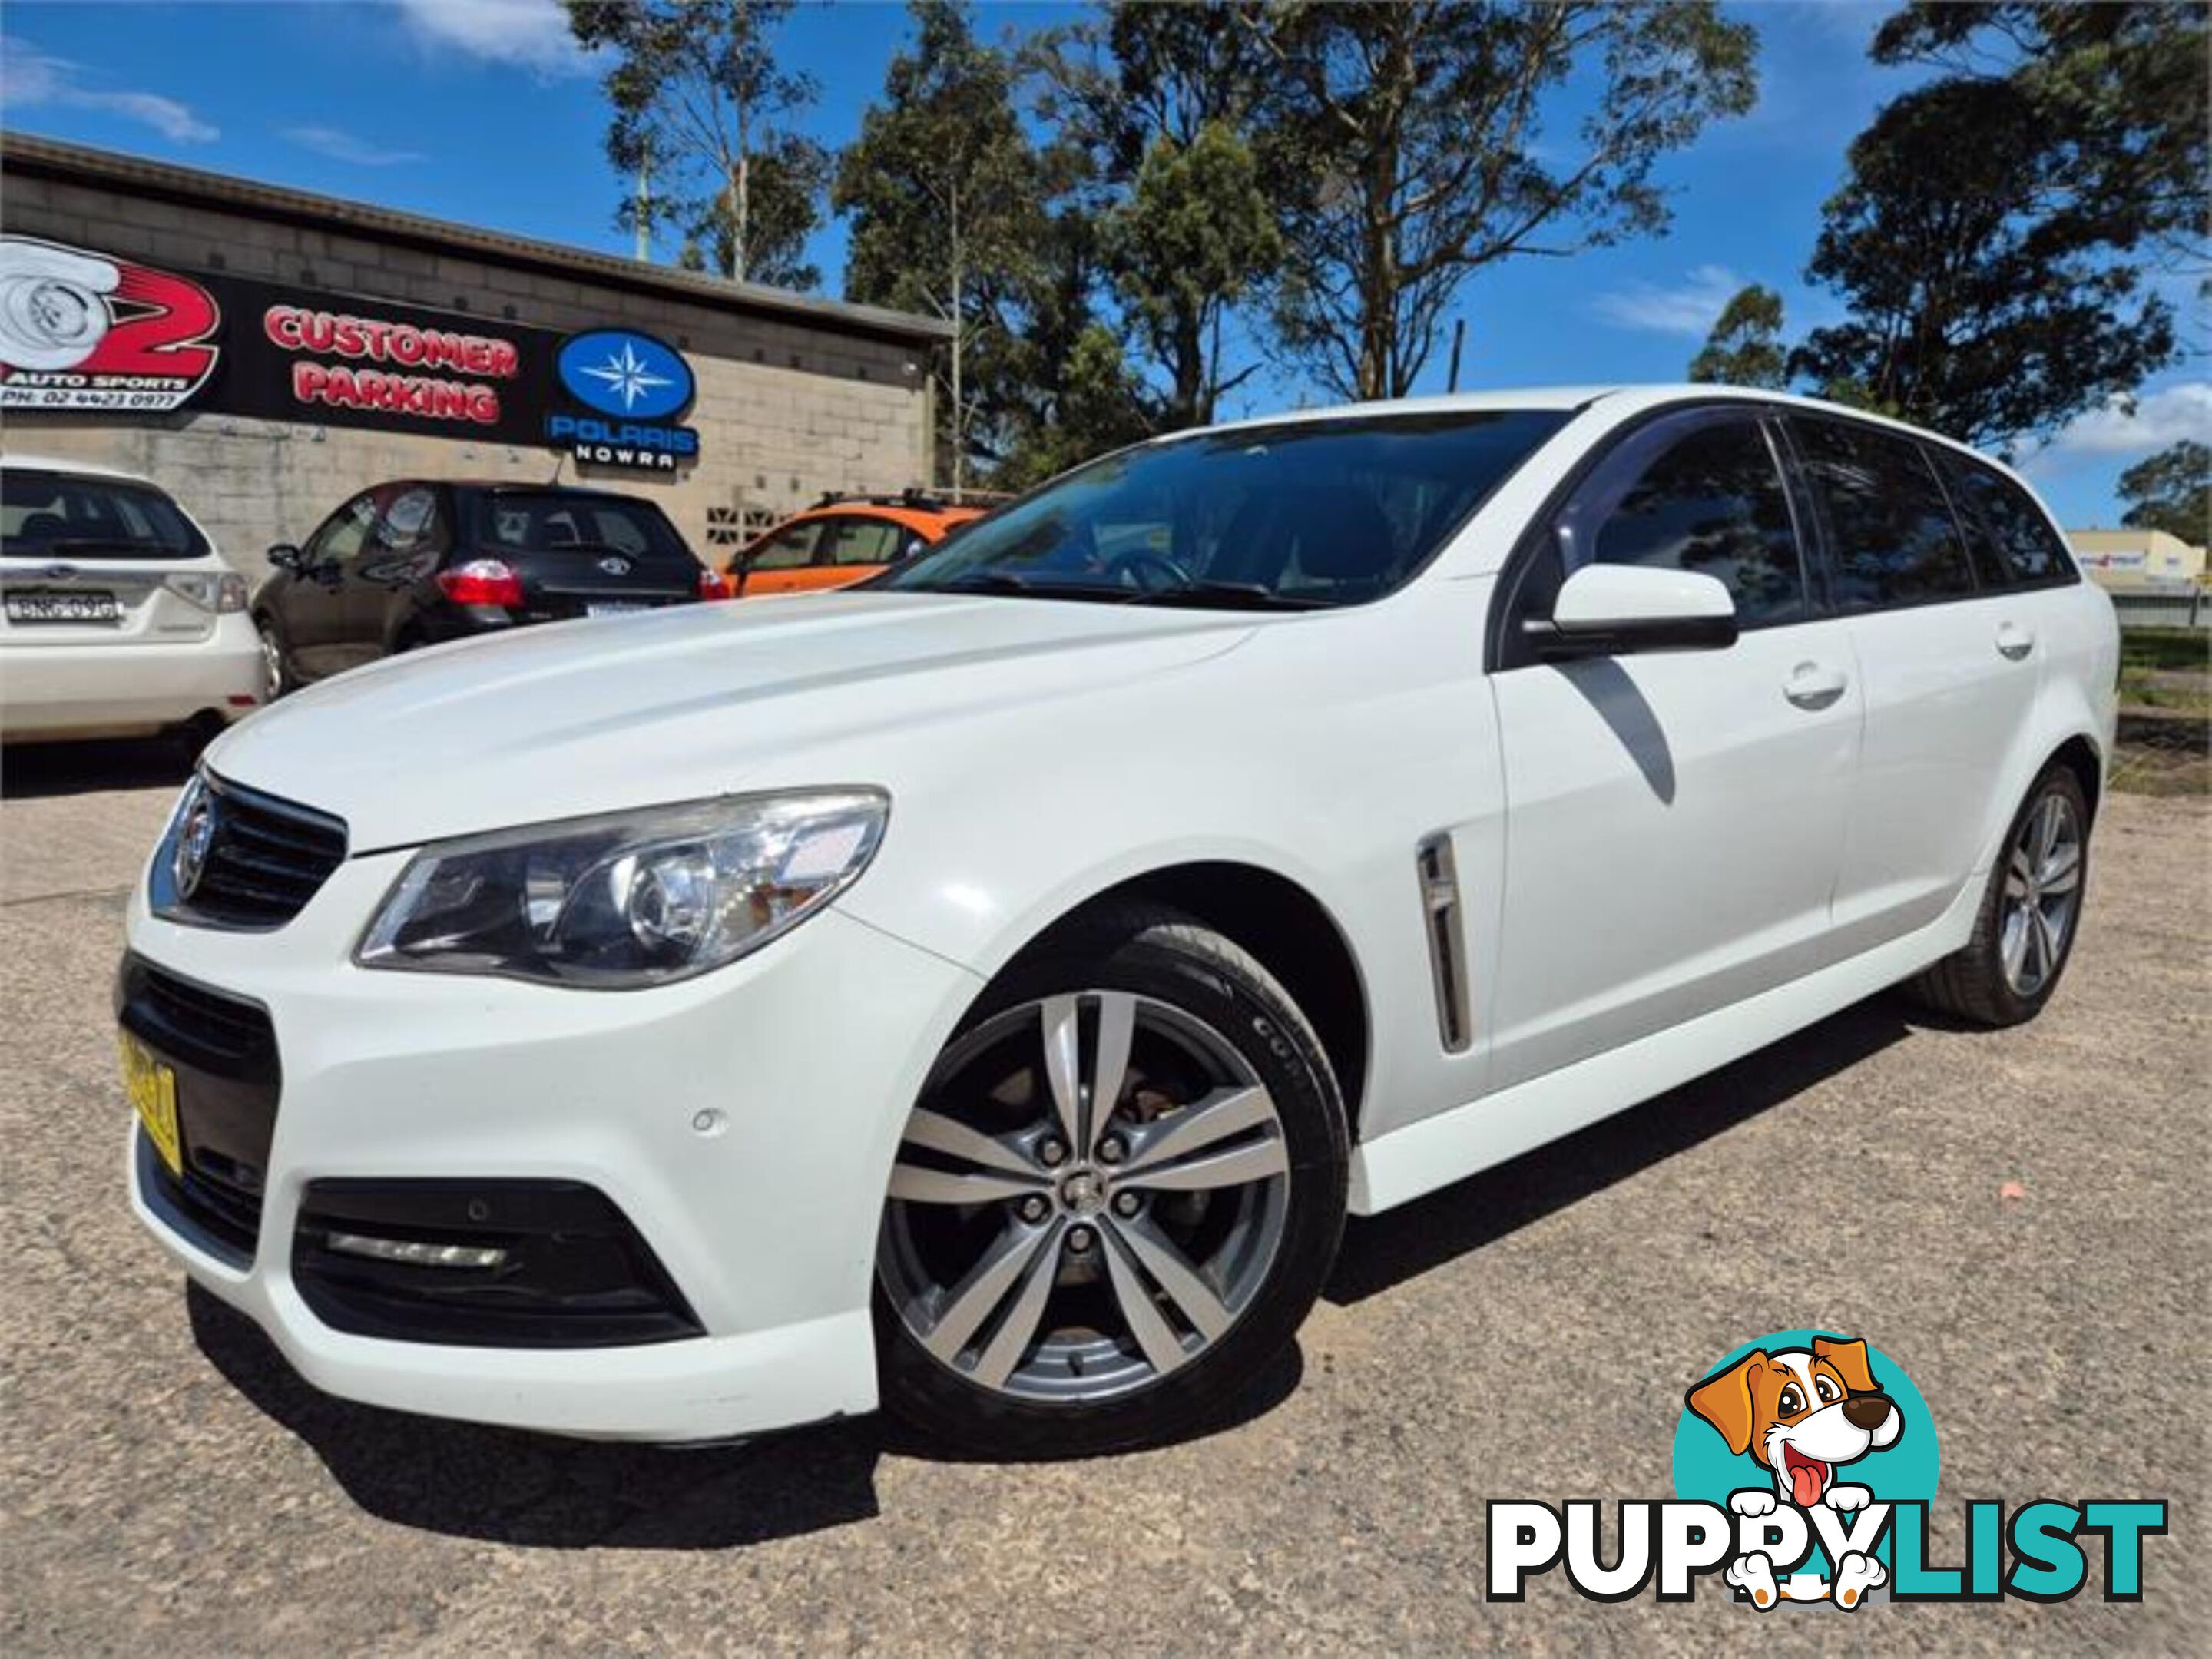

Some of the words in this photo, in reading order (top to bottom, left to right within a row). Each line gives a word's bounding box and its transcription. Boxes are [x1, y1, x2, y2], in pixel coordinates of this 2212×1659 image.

[265, 305, 519, 379] CUSTOMER
[6, 372, 88, 388] AUTO
[92, 374, 187, 391] SPORTS
[293, 360, 502, 425] PARKING
[43, 391, 70, 404] 02
[550, 416, 695, 452] POLARIS
[576, 443, 674, 468] NOWRA
